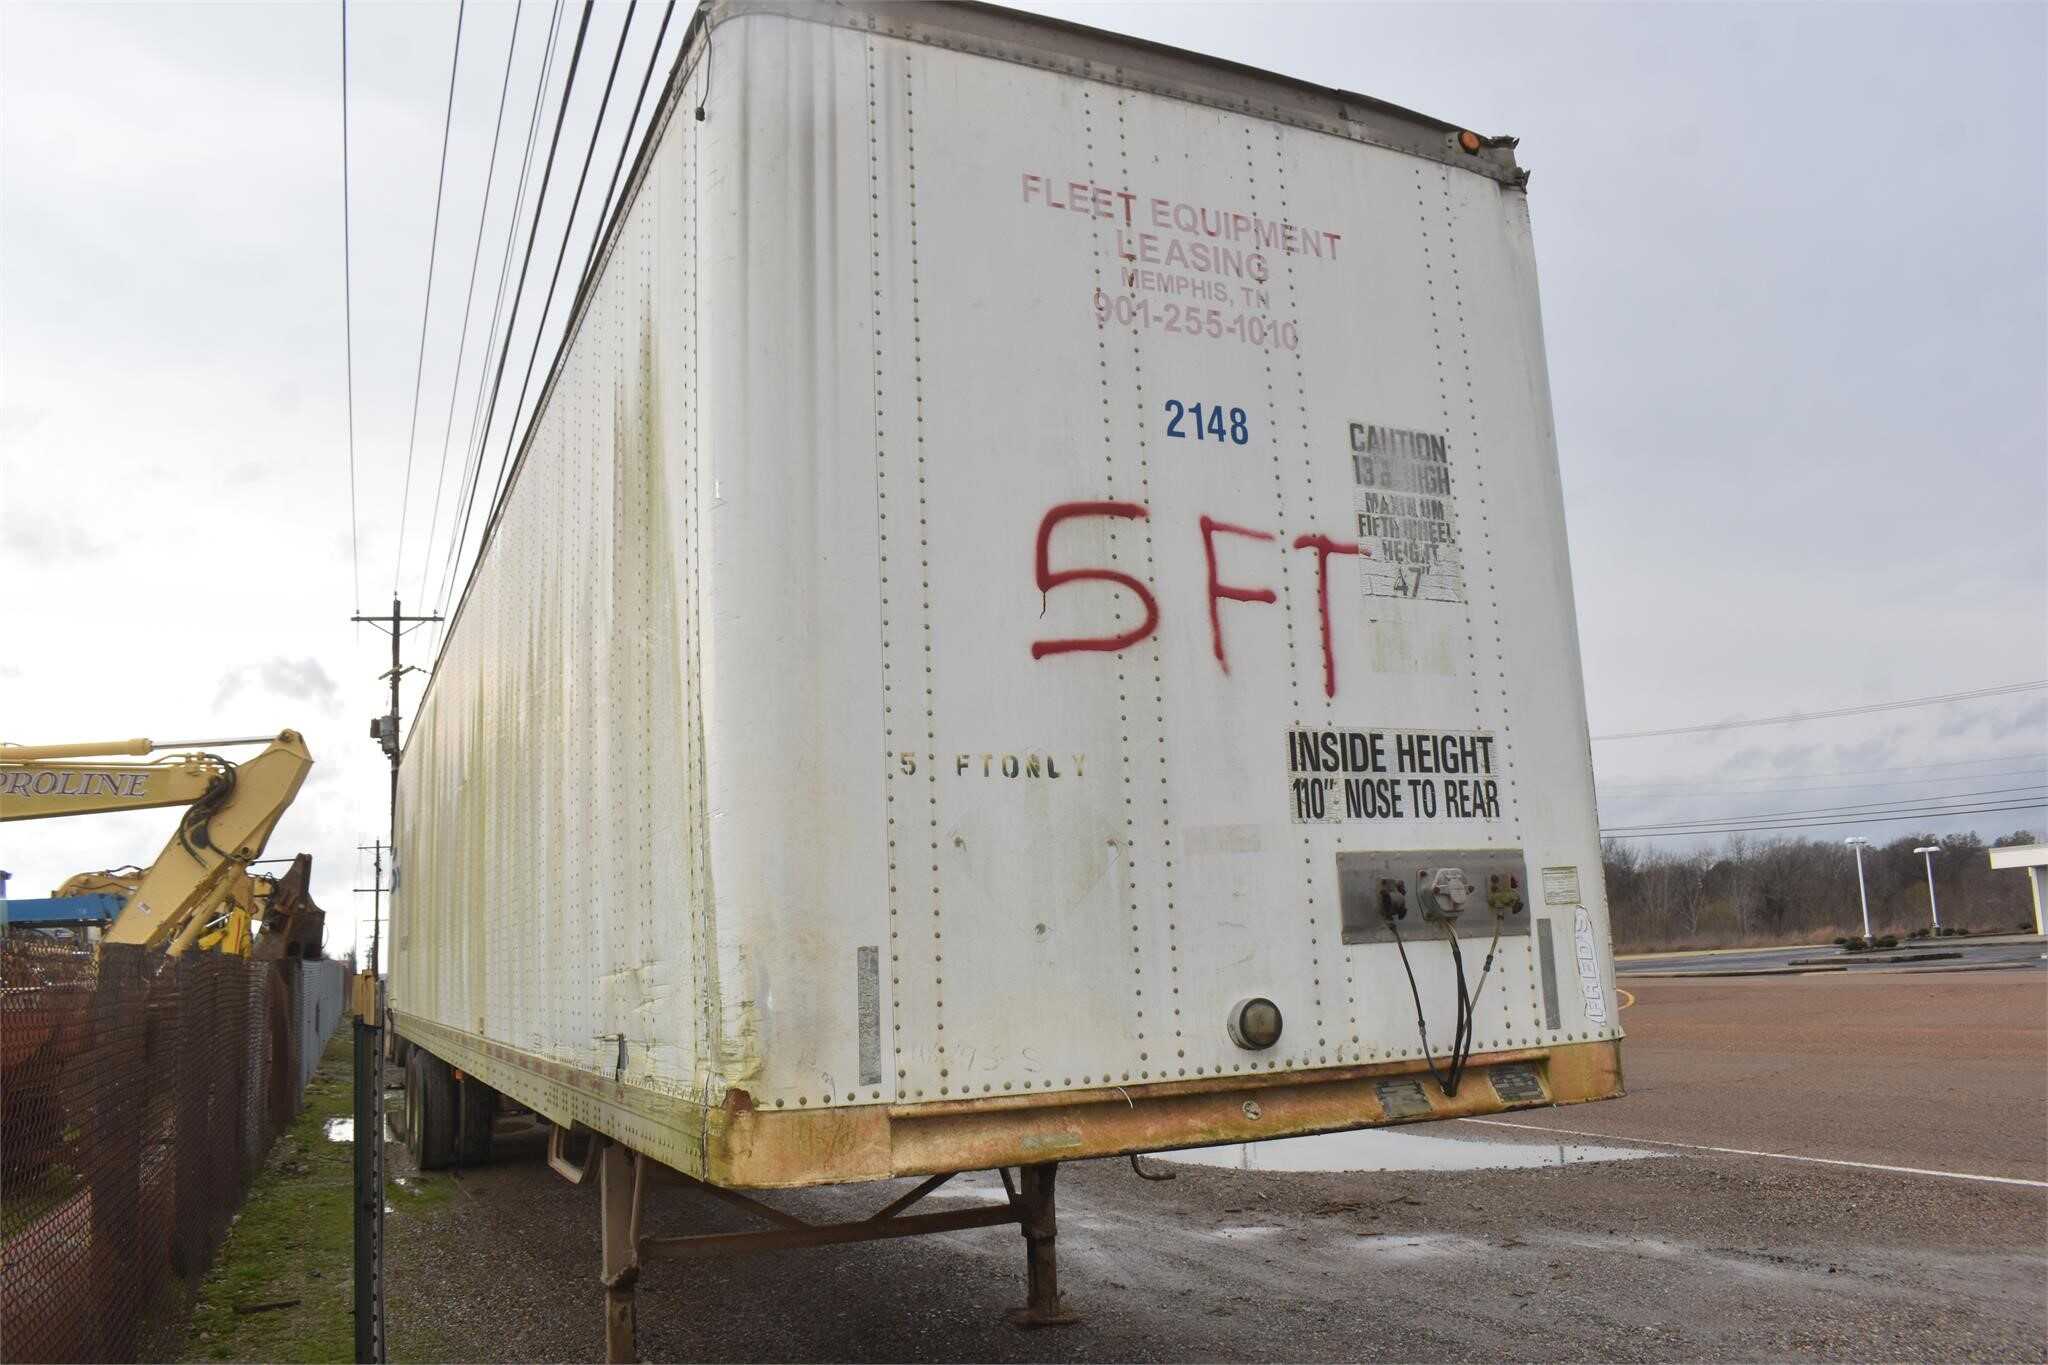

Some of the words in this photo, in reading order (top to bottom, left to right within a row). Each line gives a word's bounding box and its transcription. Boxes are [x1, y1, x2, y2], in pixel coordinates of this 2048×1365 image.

[1022, 174, 1137, 226] FLEET
[1150, 198, 1342, 261] EQUIPMENT
[1115, 229, 1269, 283] LEASING
[1240, 286, 1270, 310] TN
[1094, 291, 1299, 351] 901-255-1010
[1164, 399, 1250, 445] 2148
[1349, 422, 1448, 464] CAUTION
[900, 751, 917, 776] 5
[1288, 730, 1387, 773] INSIDE
[1396, 733, 1494, 775] HEIGHT
[1345, 777, 1404, 819] NOSE
[1408, 779, 1438, 819] TO
[1444, 779, 1501, 819] REAR
